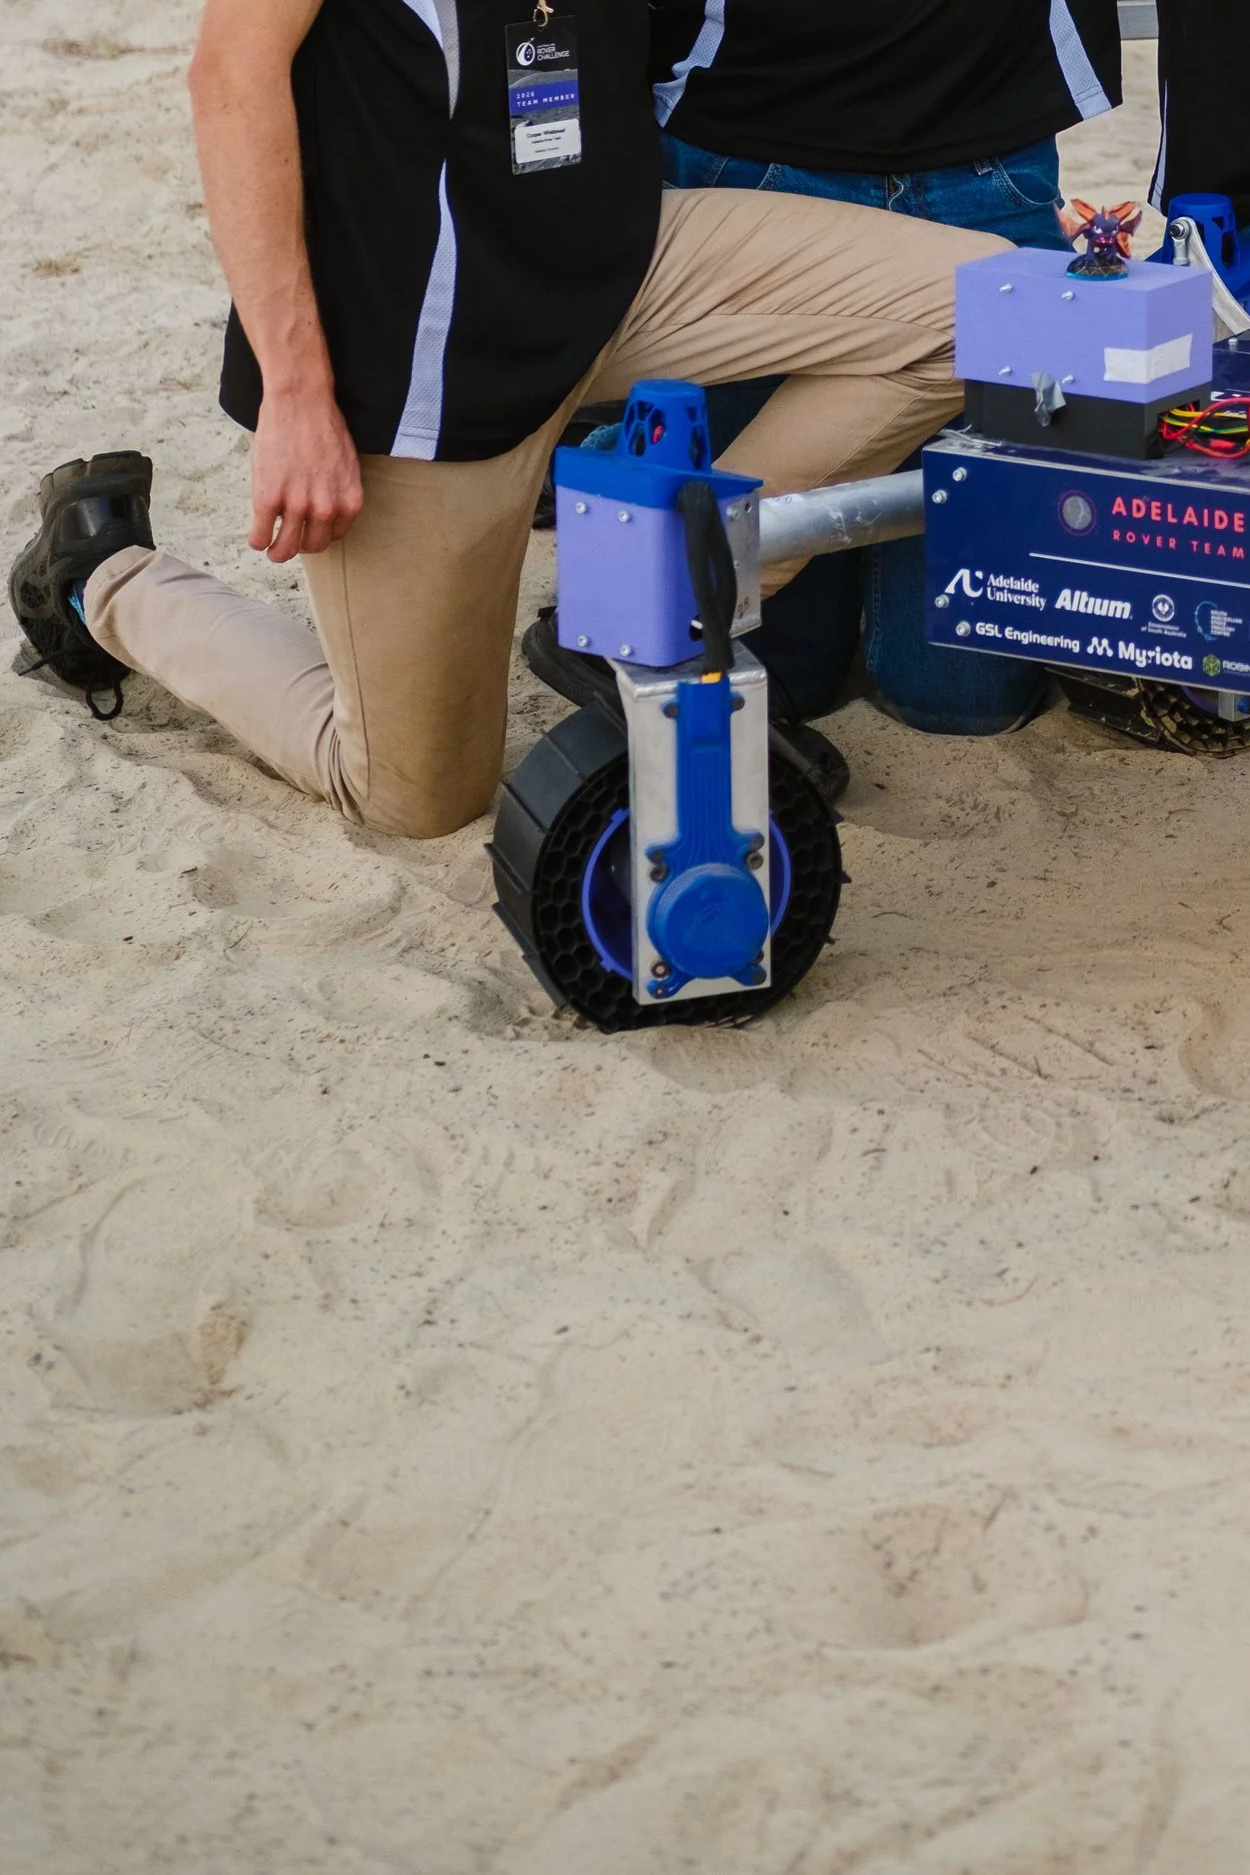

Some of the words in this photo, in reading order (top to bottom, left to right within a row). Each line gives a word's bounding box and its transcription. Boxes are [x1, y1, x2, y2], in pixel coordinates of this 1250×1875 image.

[537, 45, 556, 55] ROVER
[537, 50, 571, 61] CHALLENGE
[517, 99, 539, 108] TEAM
[542, 93, 576, 104] MEMBER
[1111, 496, 1245, 533] ADELAIDE
[1113, 529, 1176, 549] ROVER
[1191, 541, 1245, 558] TEAM
[987, 573, 1040, 593] Adelaide
[986, 586, 1047, 612] University
[1055, 588, 1130, 620] Altium
[975, 622, 1002, 638] GSL
[1004, 627, 1081, 653] Engineering
[1118, 640, 1193, 670] Myriota
